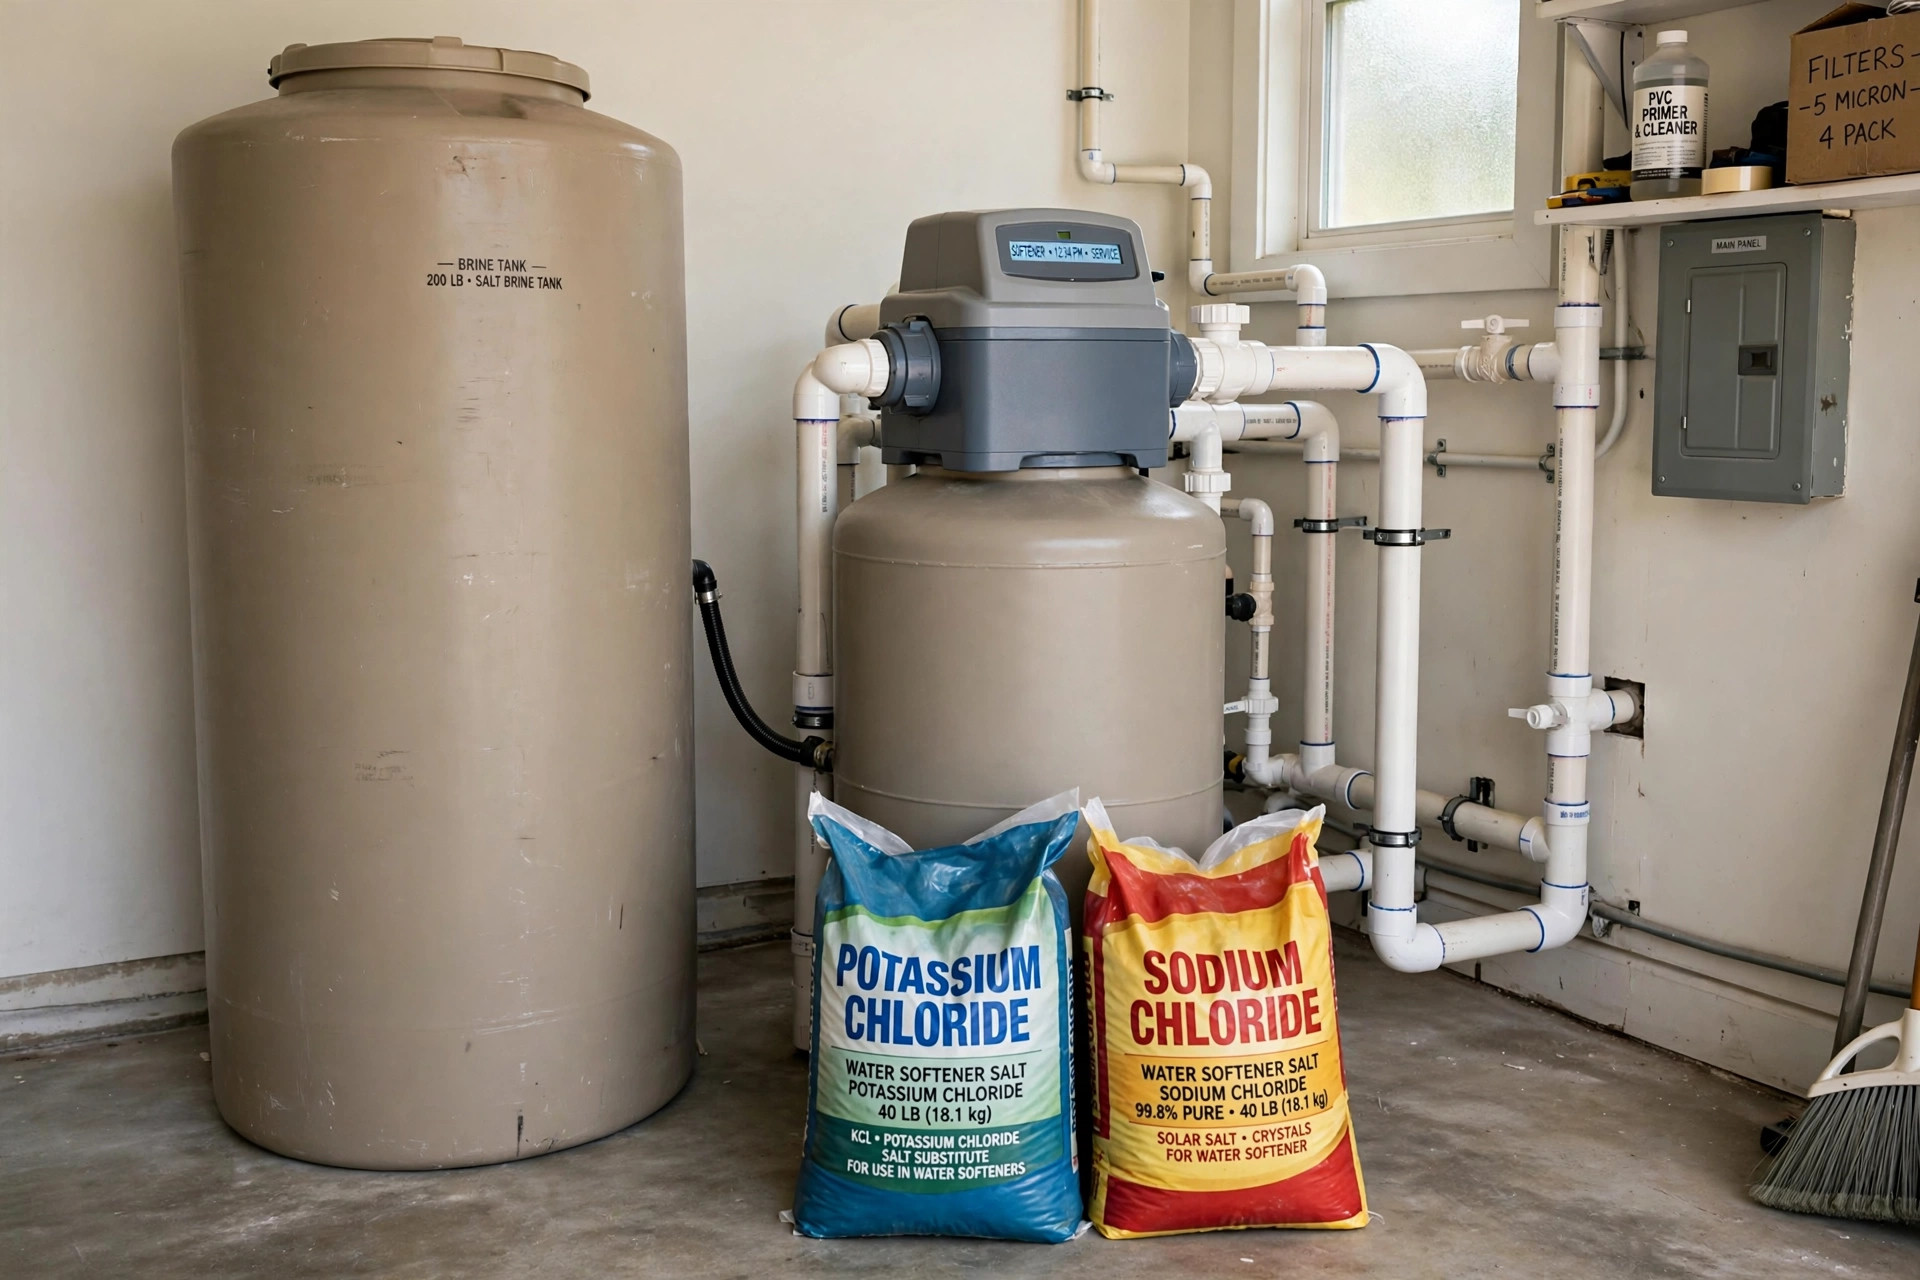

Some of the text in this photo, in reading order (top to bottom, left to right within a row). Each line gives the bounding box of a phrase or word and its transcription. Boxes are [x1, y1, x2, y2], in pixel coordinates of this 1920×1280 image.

[1649, 90, 1672, 105] PVC
[1642, 105, 1688, 122] PRIMER
[1635, 121, 1697, 138] & CLEANER
[1819, 118, 1896, 149] 4 PACK
[1011, 244, 1045, 258] SOFTENER
[1091, 248, 1119, 260] SERVICE
[1716, 239, 1762, 249] MAIN PANEL
[458, 258, 527, 272] BRINE TANK
[427, 274, 563, 290] 200 LB SALT BRINE TANK
[836, 943, 1041, 997] POTASSIUM
[1143, 940, 1303, 995] SODIUM
[845, 995, 1030, 1047] CHLORIDE
[1130, 988, 1322, 1046] CHLORIDE
[846, 1059, 1027, 1082] WATER SOFTENER SALT
[1141, 1053, 1319, 1082] WATER SOFTENER SALT
[849, 1080, 1023, 1102] POTASSIUM CHLORIDE
[1160, 1076, 1307, 1102] SODIUM CHLORIDE
[878, 1104, 992, 1126] 40 LB (18.1 kg)
[1135, 1089, 1328, 1120] 99.8% PURE 40 LB (18.1 kg)
[851, 1129, 1020, 1148] KCL POTASSIUM CHLORIDE
[1157, 1122, 1312, 1146] SOLAR SALT CRYSTALS
[882, 1149, 989, 1164] SALT SUBSTITUTE
[1166, 1140, 1308, 1163] FOR WATER SOFTENER
[847, 1159, 1026, 1180] FOR USE IN WATER SOFTENERS
